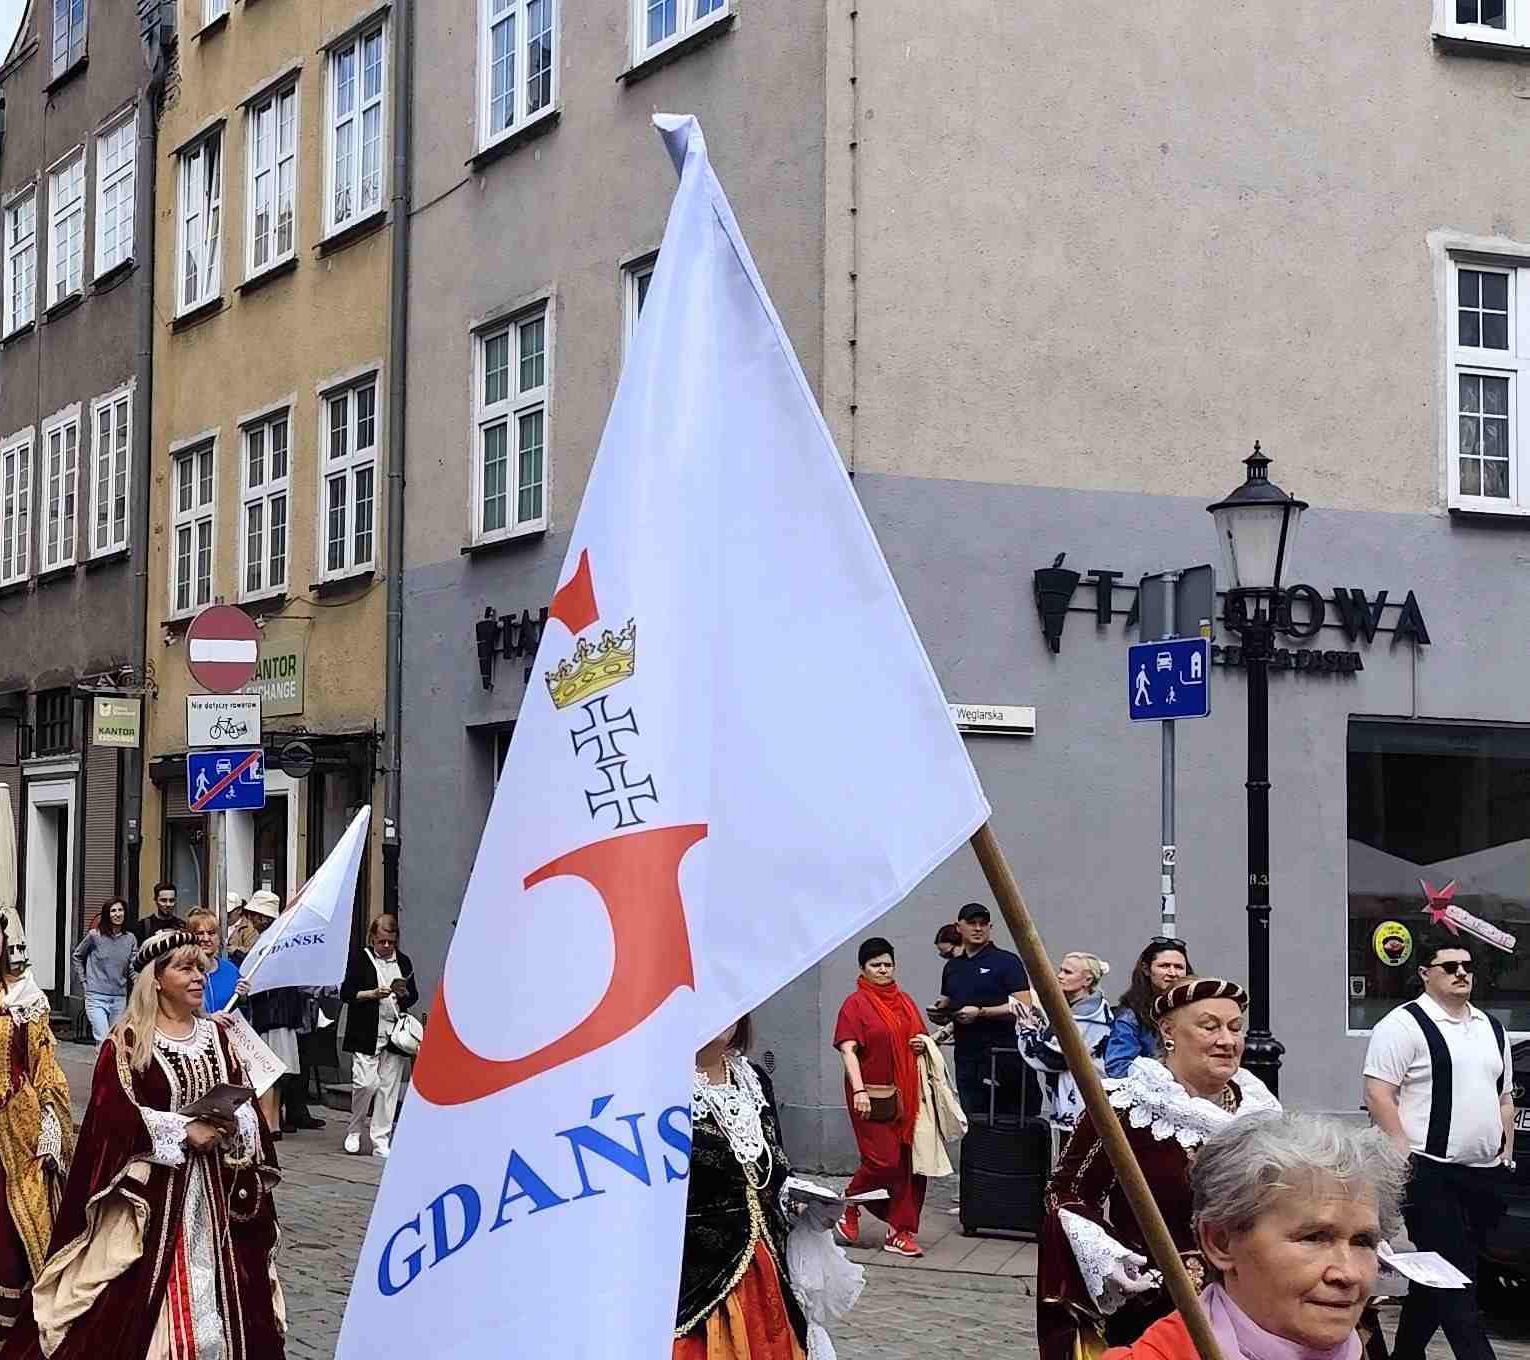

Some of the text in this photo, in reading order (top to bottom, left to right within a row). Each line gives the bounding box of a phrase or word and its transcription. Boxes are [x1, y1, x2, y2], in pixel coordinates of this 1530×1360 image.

[250, 654, 297, 681] ANTOR
[191, 701, 203, 710] Nie
[98, 727, 135, 736] KANTOR
